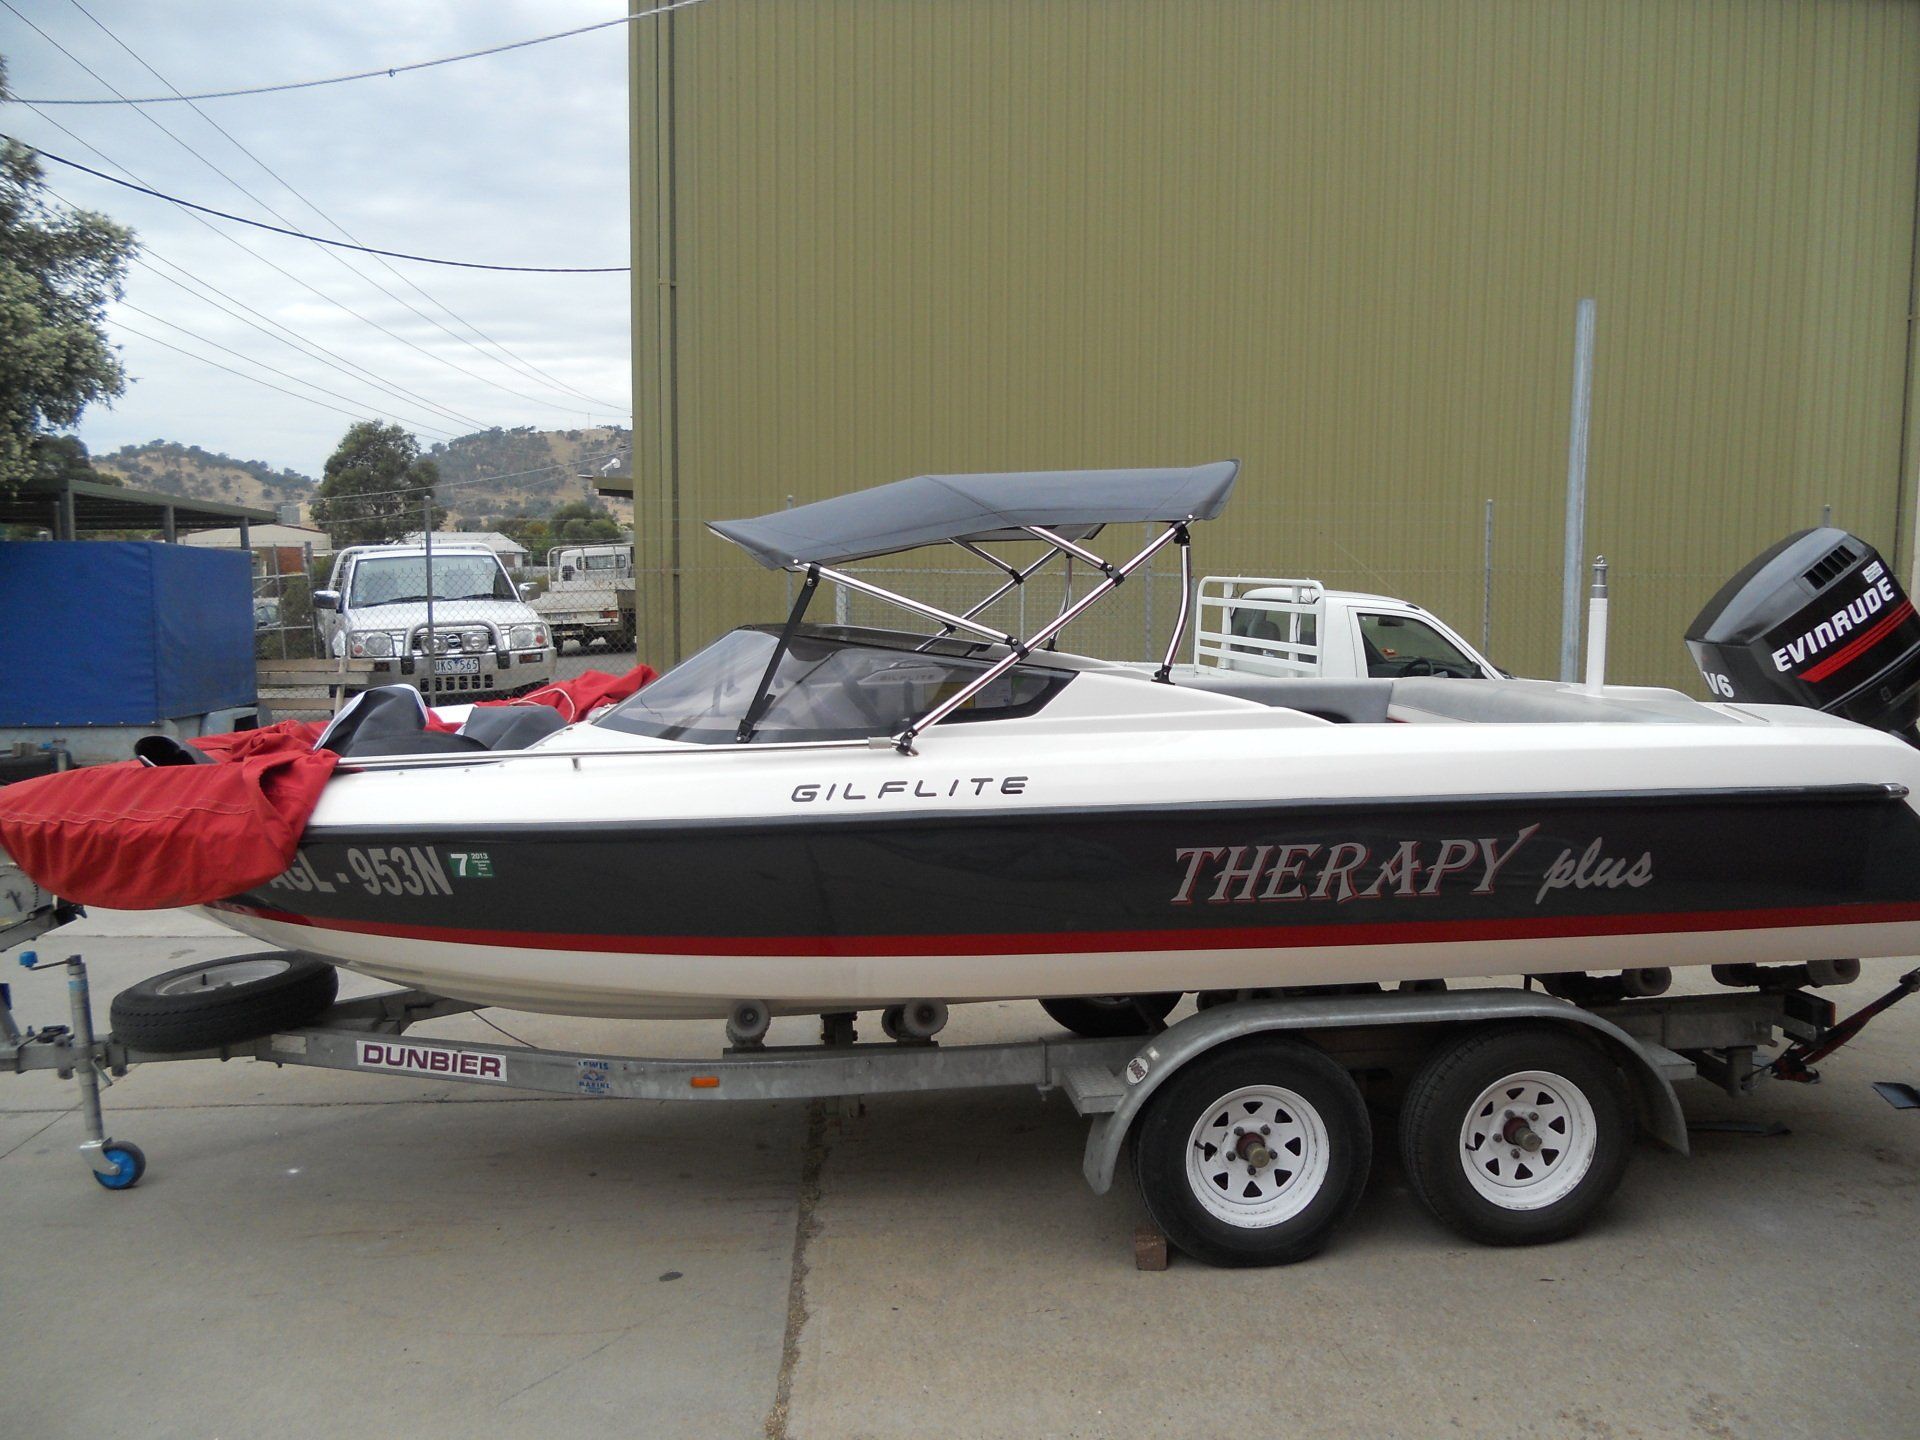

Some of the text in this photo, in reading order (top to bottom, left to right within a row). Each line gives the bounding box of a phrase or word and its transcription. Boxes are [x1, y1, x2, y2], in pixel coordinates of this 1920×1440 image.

[1771, 577, 1895, 672] EVINRUDE
[460, 659, 478, 671] 565
[1702, 671, 1735, 698] V6
[791, 776, 1029, 802] GILFLITE
[450, 853, 468, 876] 7
[470, 852, 489, 860] 2013
[1171, 822, 1654, 904] THERAPY plus
[363, 1044, 502, 1077] DUNBIER
